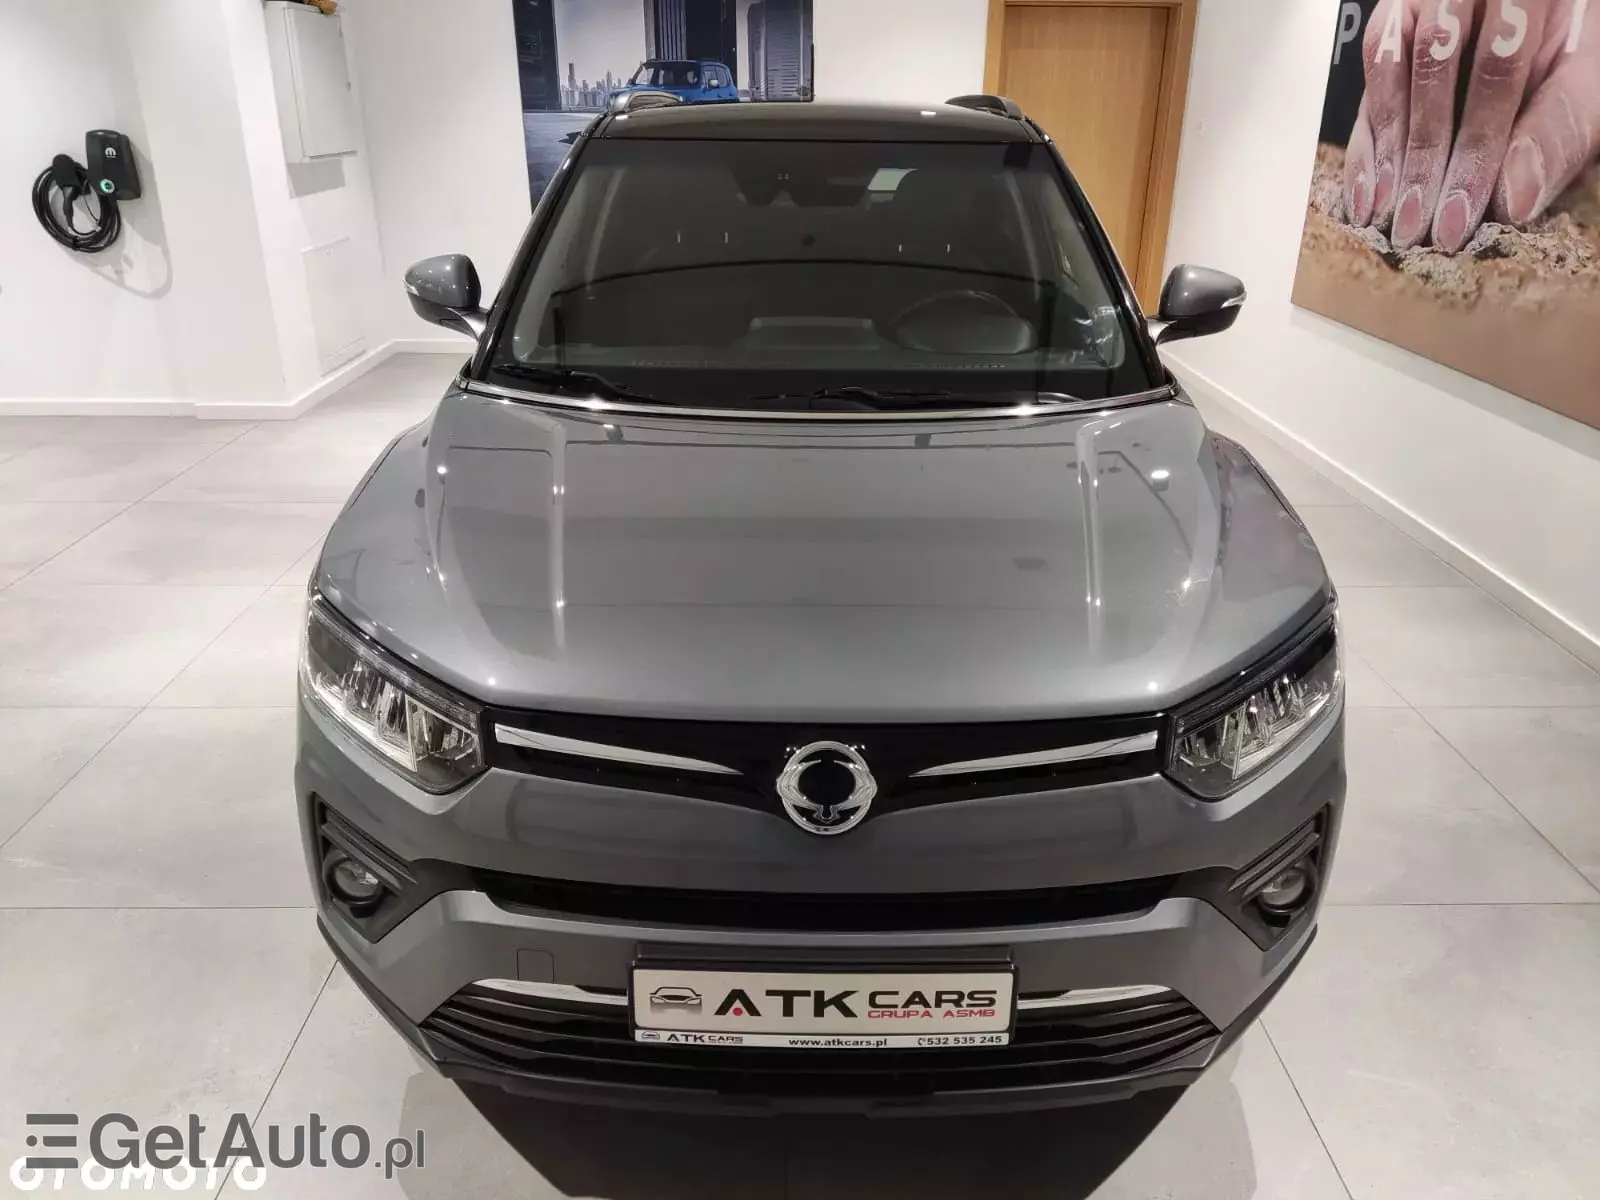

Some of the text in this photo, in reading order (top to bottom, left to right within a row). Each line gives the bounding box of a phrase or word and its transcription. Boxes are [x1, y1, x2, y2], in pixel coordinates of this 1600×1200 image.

[714, 989, 997, 1018] ATK CARS
[867, 1009, 996, 1019] GRUPA ASMB
[666, 1033, 705, 1043] ATK
[788, 1037, 888, 1048] www.atkcars.pl
[926, 1035, 1003, 1046] 532 535 245
